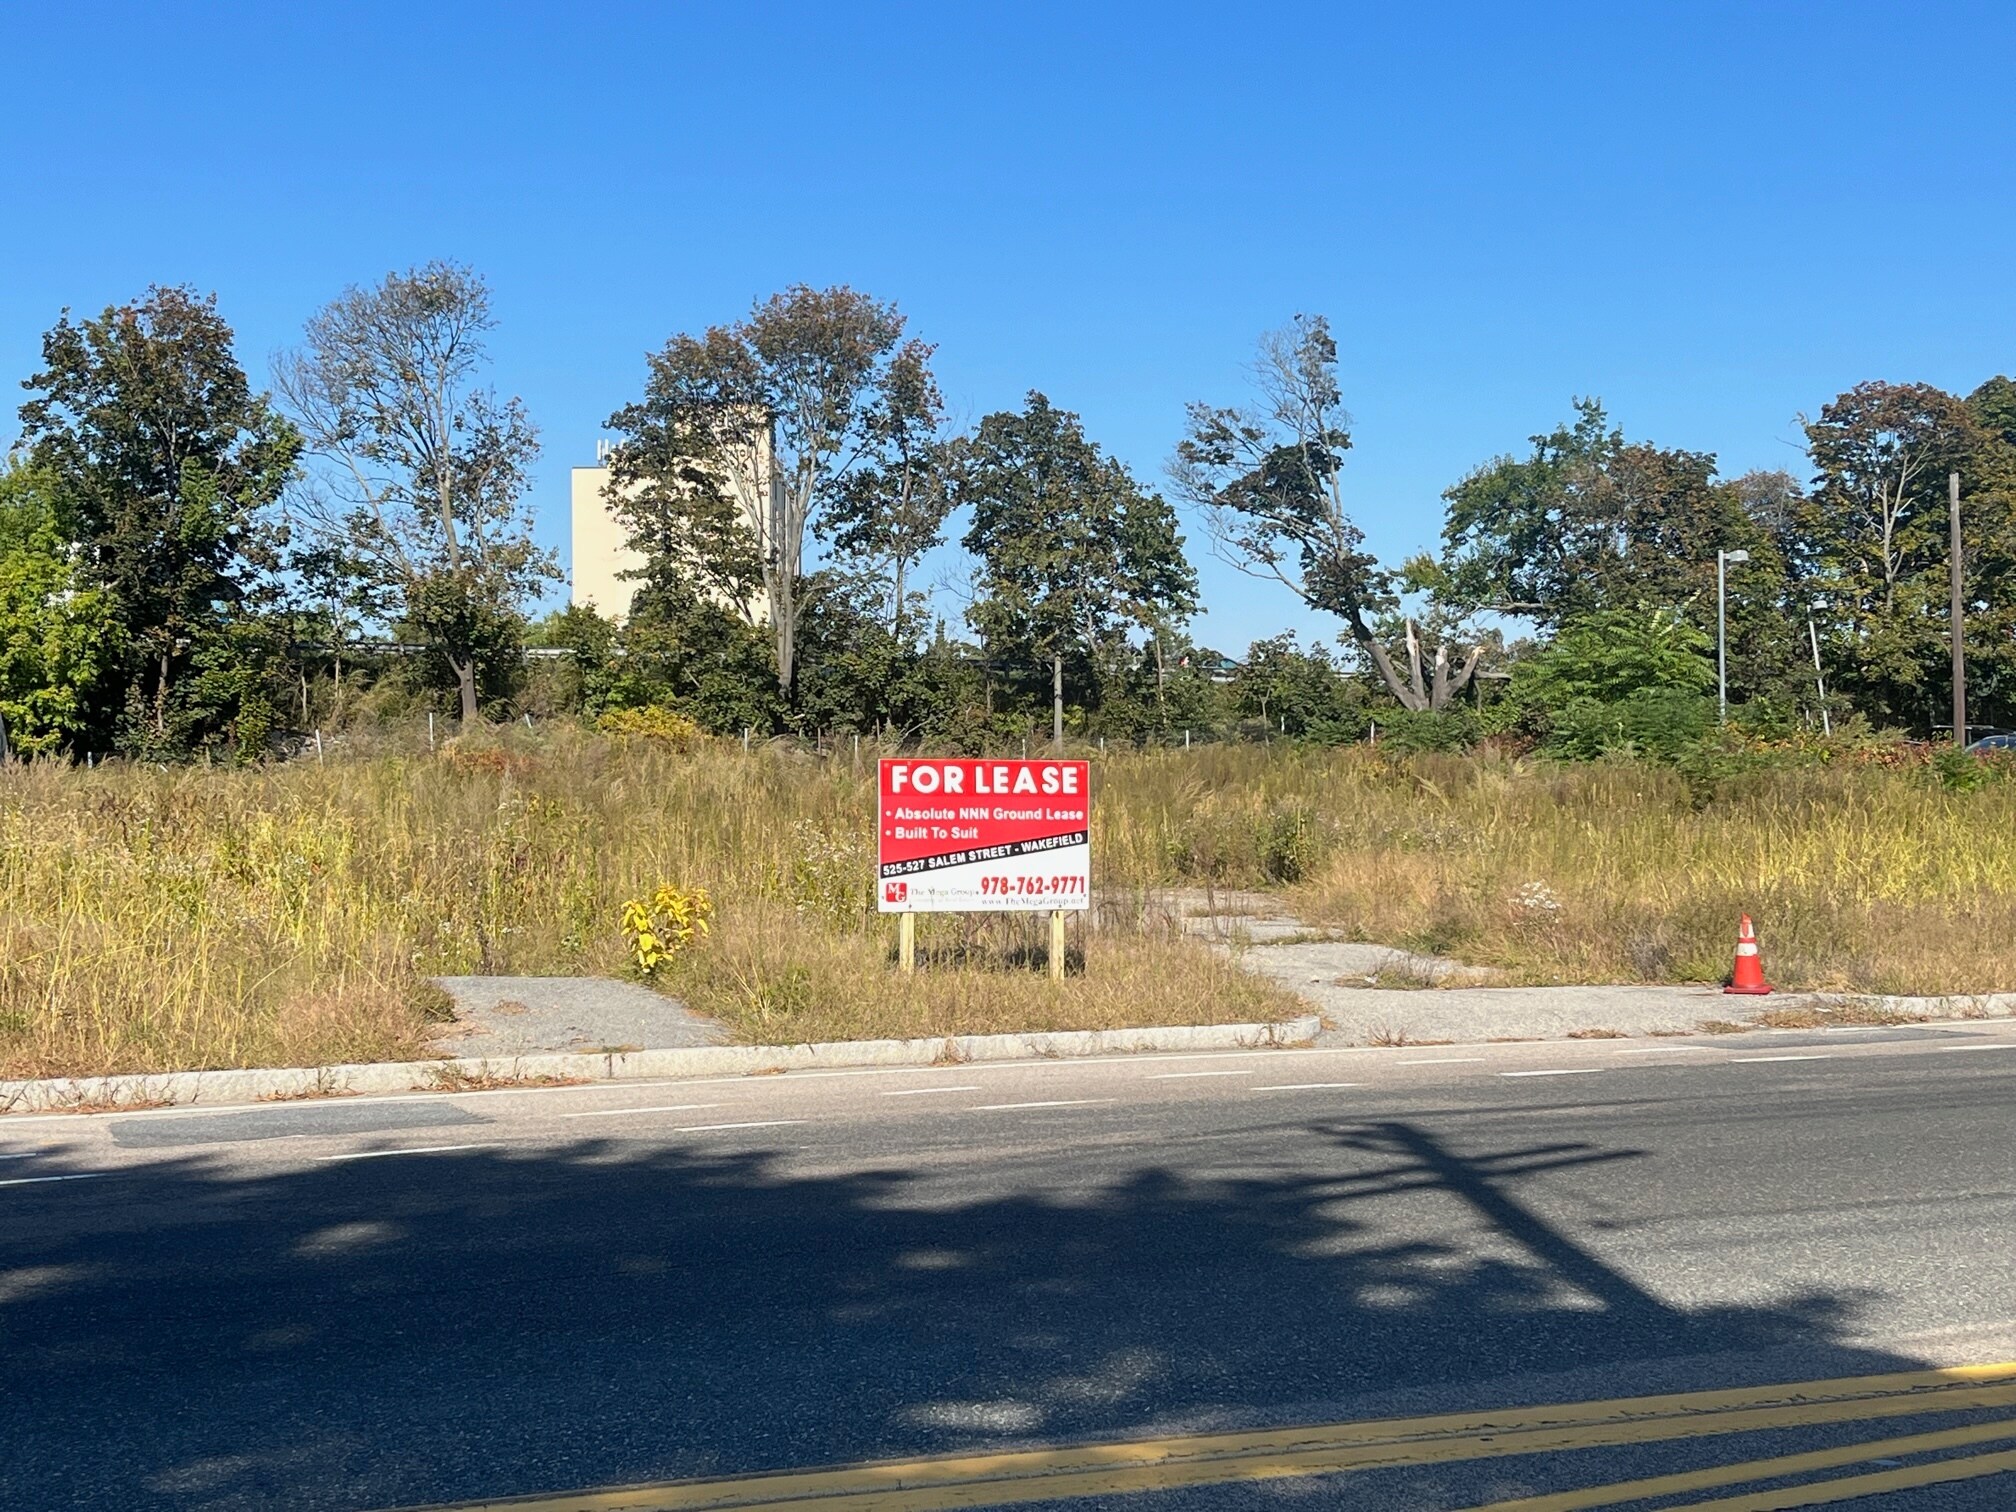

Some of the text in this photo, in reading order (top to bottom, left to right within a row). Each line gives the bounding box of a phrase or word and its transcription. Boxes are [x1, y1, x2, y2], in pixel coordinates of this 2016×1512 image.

[891, 765, 1078, 794] FOR LEASE
[894, 808, 1083, 820] Absolute NNN Ground Lease
[895, 827, 978, 839] Built To Suit
[883, 859, 925, 876] 525-527
[928, 853, 966, 868] SALEM
[968, 845, 1012, 861] STREET
[1021, 833, 1083, 853] WAKEFIELD
[981, 876, 1085, 895] 978-762-9771
[982, 897, 1084, 906] wwwTheMegaGroupnet
